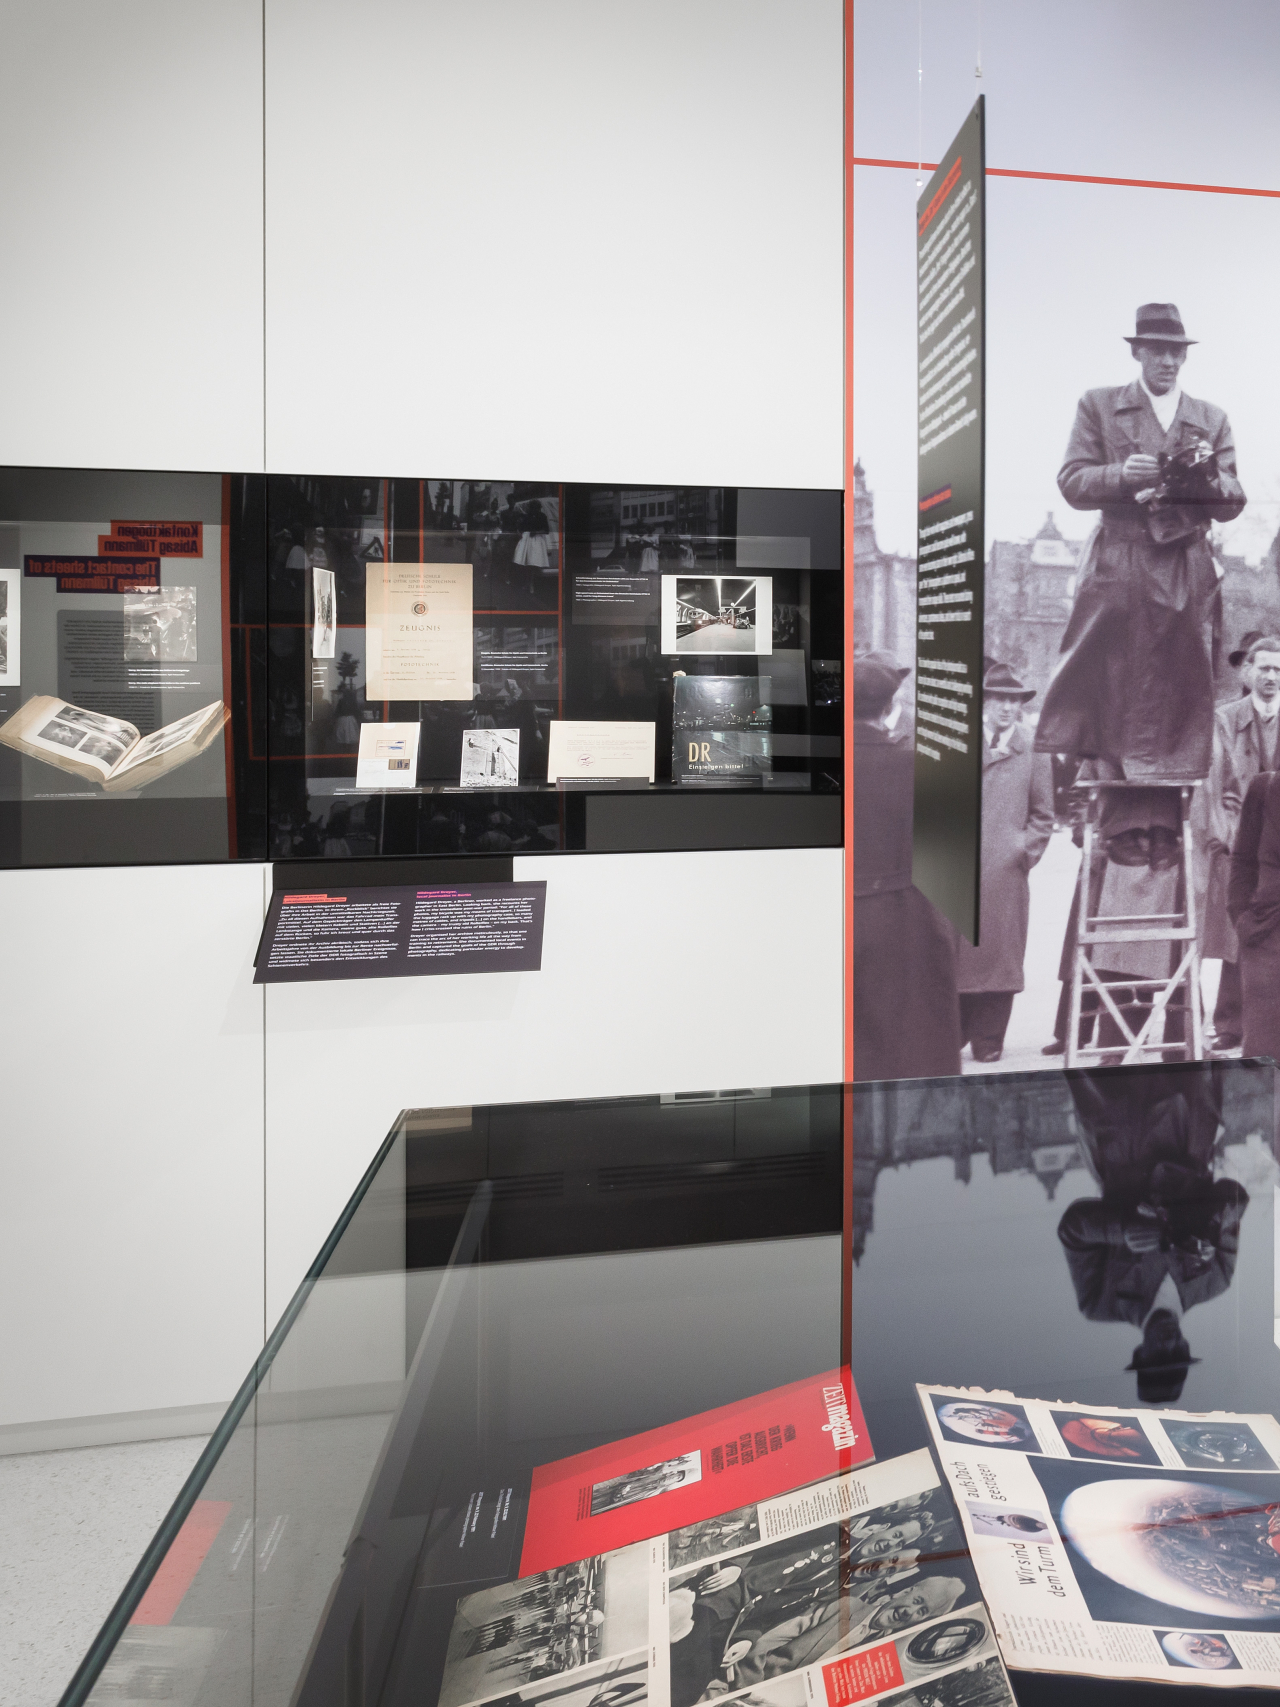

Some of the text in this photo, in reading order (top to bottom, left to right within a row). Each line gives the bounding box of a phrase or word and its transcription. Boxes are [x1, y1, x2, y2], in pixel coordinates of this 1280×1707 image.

[399, 624, 441, 632] ZEUGNIS
[688, 742, 712, 762] DR
[820, 1382, 857, 1451] ZEITmagazin
[950, 1461, 980, 1498] aufs Dach
[976, 1463, 1007, 1502] gestiegen
[1007, 1542, 1037, 1585] Wir sind
[1037, 1546, 1066, 1597] dem Turm
